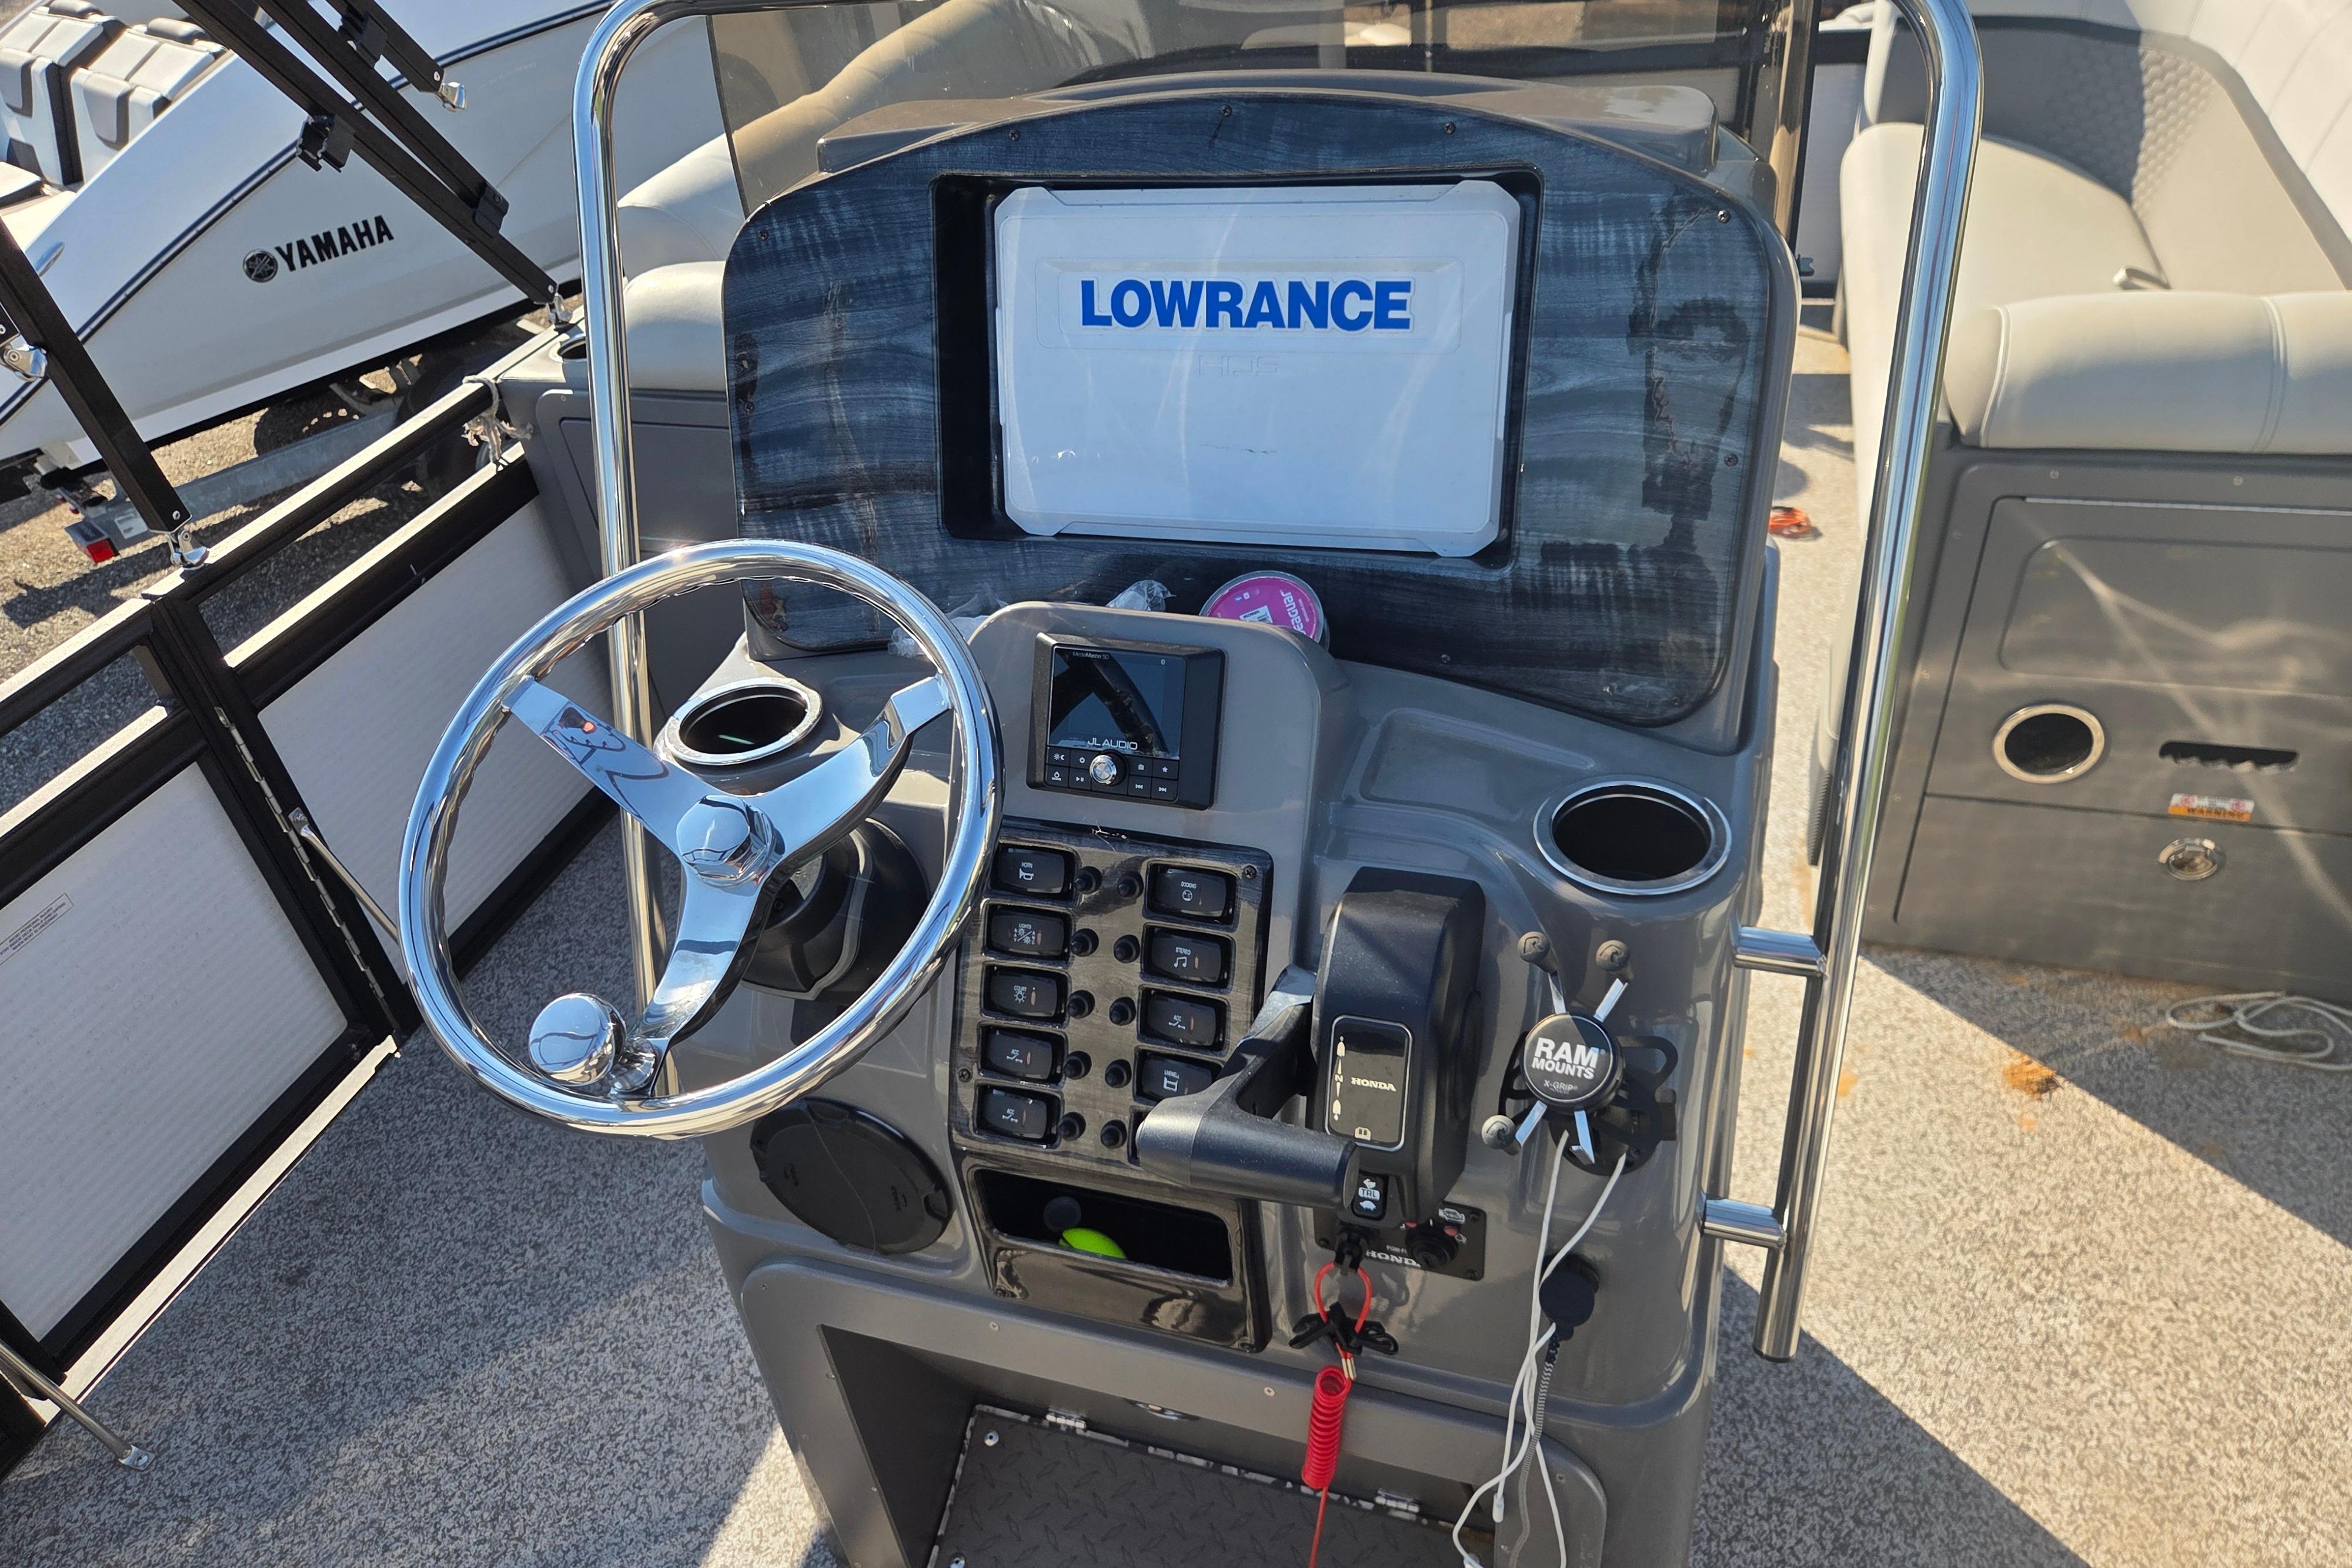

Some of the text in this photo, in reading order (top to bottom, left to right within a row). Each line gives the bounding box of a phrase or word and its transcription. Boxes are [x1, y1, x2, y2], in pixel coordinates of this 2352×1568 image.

[275, 215, 394, 272] YAMAHA
[1081, 279, 1411, 332] LOWRANCE
[1087, 737, 1138, 750] JL AUDIO
[1534, 1037, 1599, 1069] RAM
[1531, 1057, 1595, 1080] MOUNTS
[1351, 1077, 1397, 1092] HONDA
